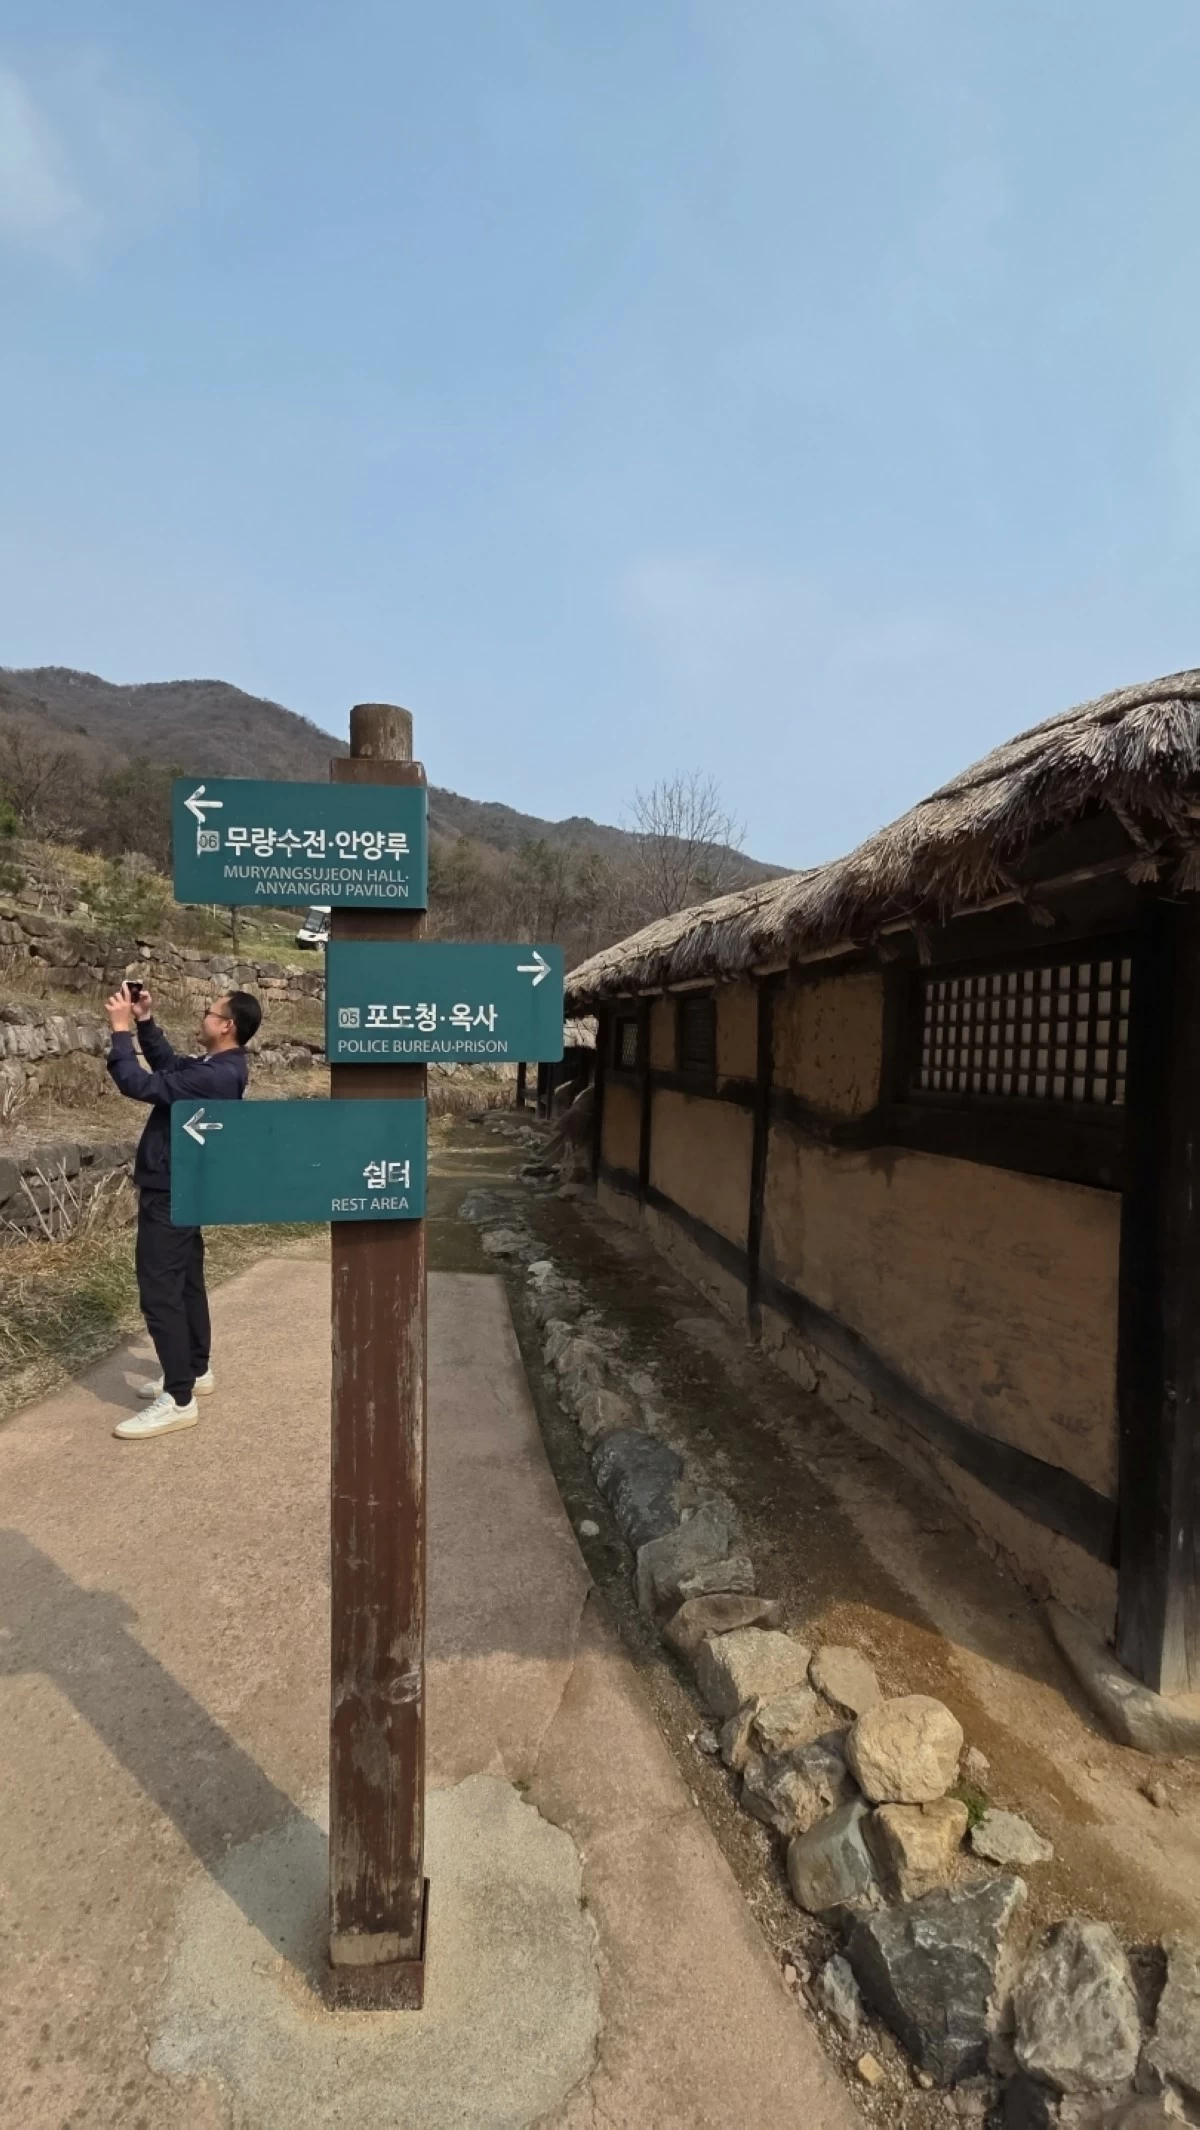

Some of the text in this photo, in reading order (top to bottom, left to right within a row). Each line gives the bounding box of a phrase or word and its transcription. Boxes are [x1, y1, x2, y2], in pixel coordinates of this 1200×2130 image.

[199, 827, 410, 861] 06 무량수전·안양루
[223, 865, 363, 882] MURYANGSUJEON
[254, 881, 409, 898] ANYANGRU PAVILON
[339, 1003, 498, 1032] 05 포도청·옥사
[337, 1039, 389, 1054] POLICE
[362, 1160, 410, 1189] 쉼터
[331, 1196, 409, 1212] REST AREA
